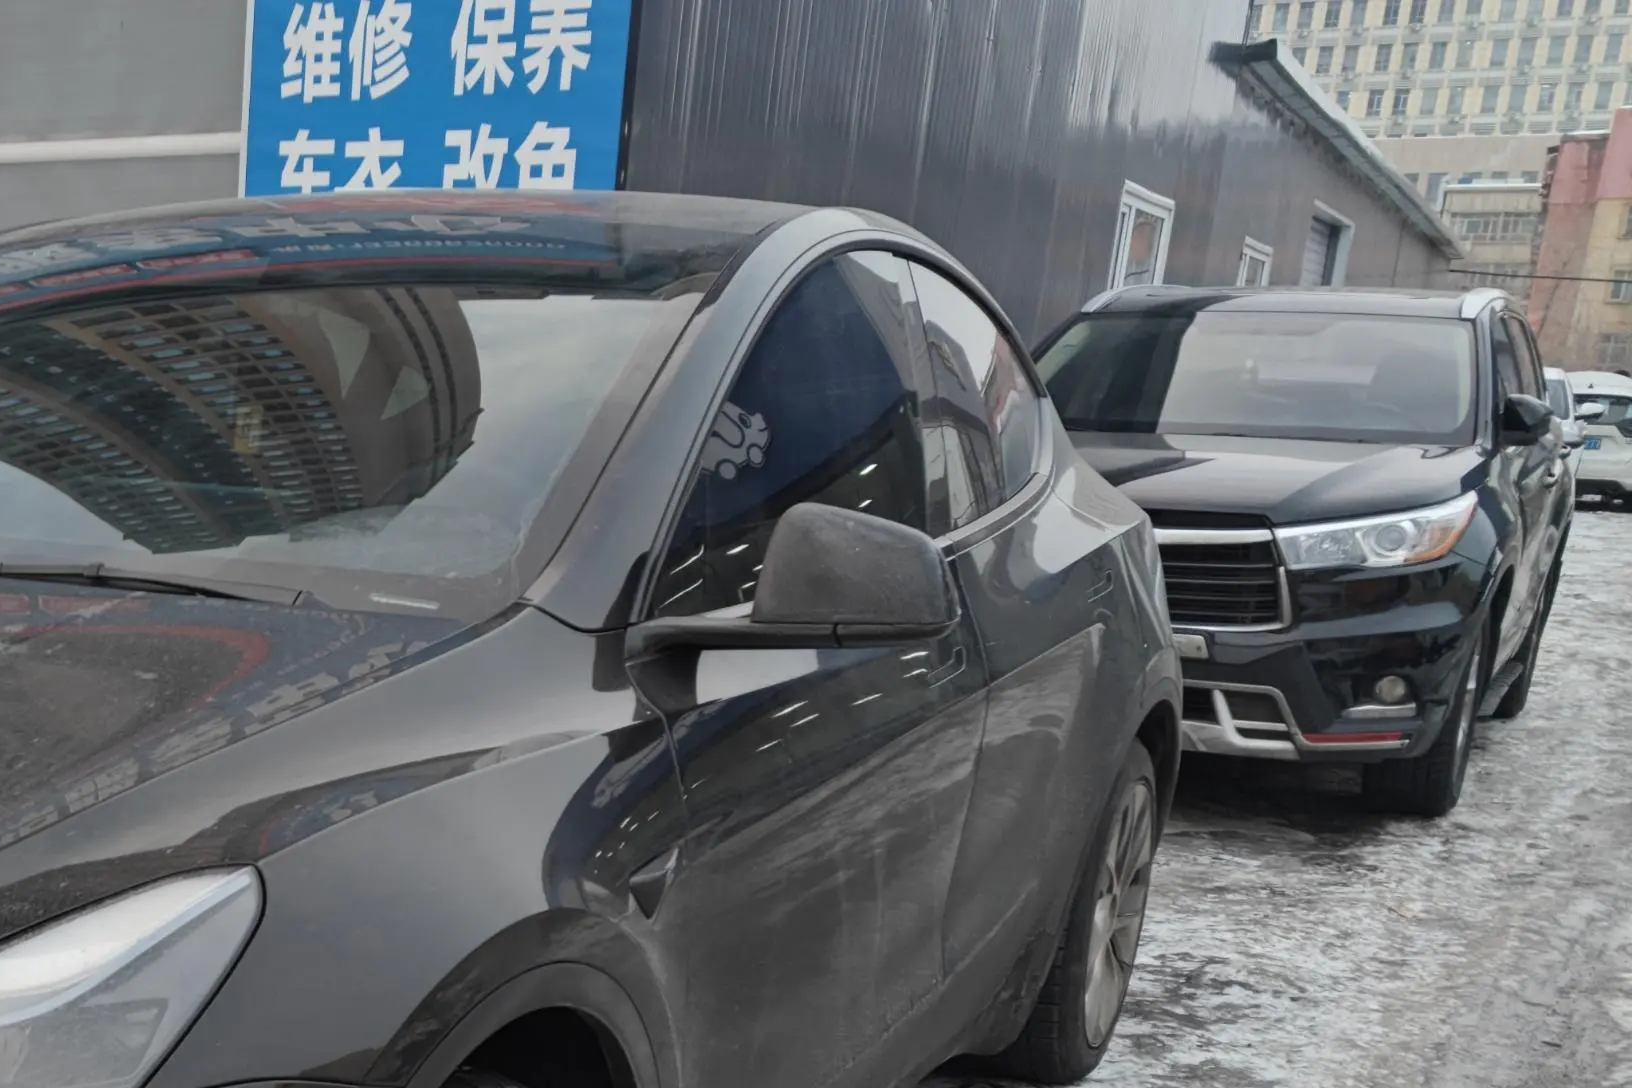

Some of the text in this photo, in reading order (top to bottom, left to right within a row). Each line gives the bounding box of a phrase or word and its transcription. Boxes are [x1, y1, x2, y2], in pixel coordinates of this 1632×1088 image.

[281, 0, 592, 103] 维修 保养
[442, 121, 576, 190] 改色
